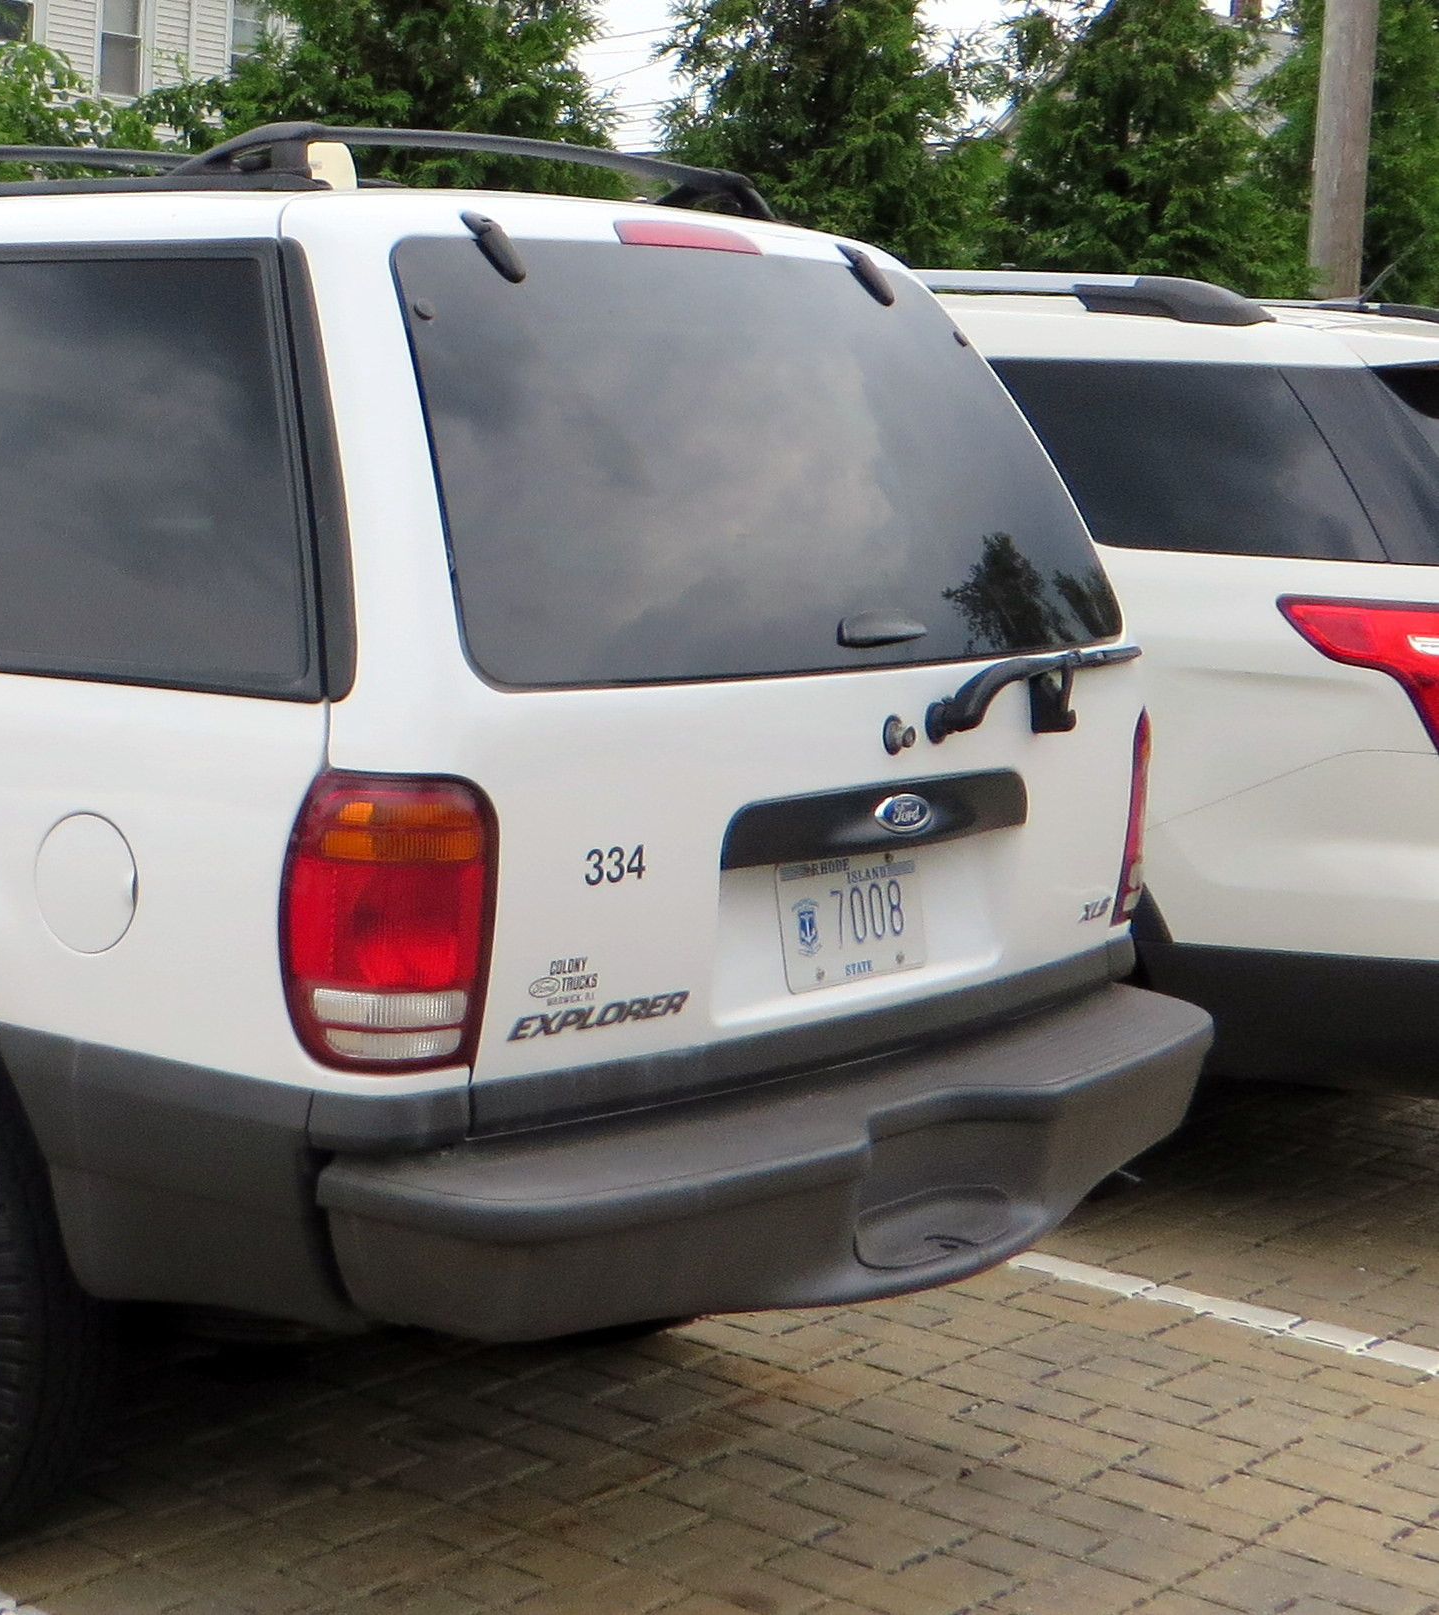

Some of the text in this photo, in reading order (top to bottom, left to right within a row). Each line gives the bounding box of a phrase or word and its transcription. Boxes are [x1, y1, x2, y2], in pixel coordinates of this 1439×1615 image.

[584, 844, 646, 886] 334
[810, 857, 851, 876] RHODE
[846, 864, 888, 884] ISLAND
[829, 879, 904, 950] 7008
[549, 956, 589, 976] COLONY
[844, 959, 874, 977] STATE
[561, 973, 599, 993] TRUCKS
[507, 989, 691, 1042] EXPLORER
